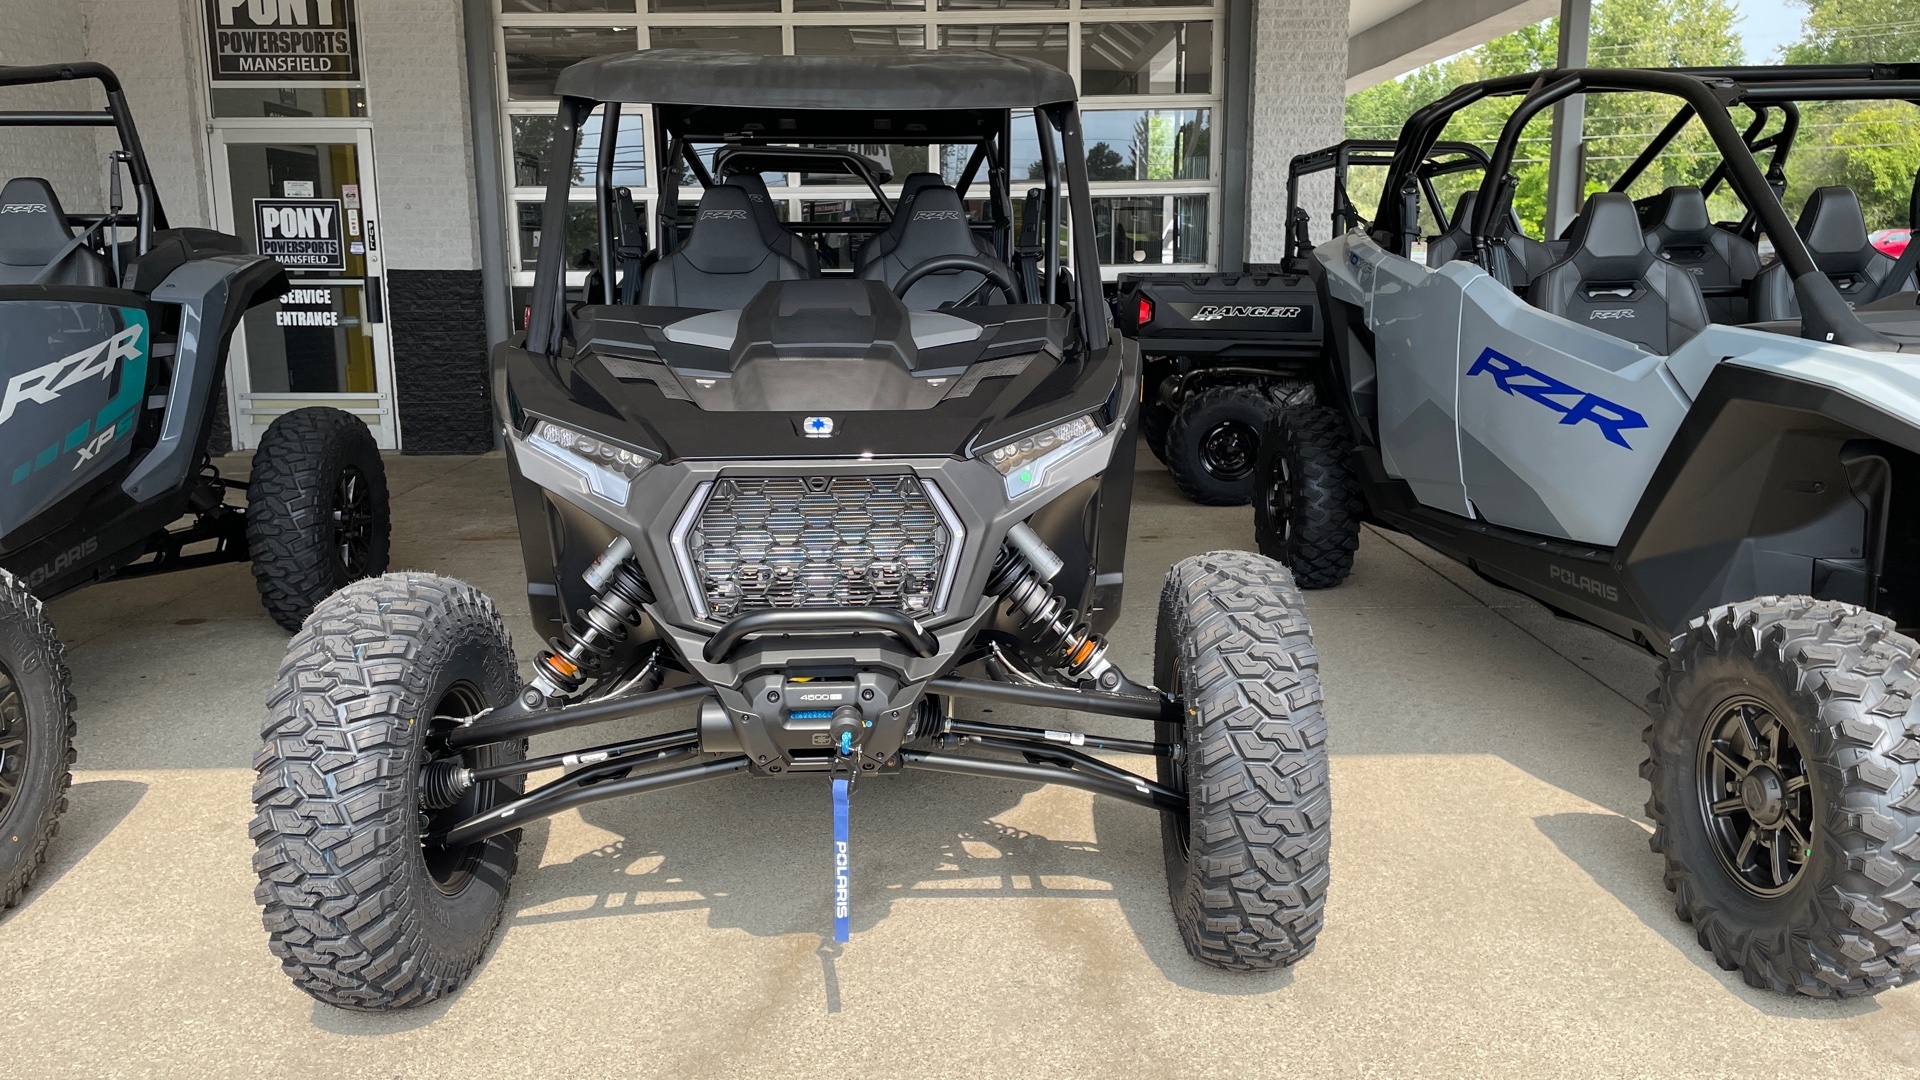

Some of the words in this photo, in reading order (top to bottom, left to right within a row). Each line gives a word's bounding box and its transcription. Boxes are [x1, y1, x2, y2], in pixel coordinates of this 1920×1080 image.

[219, 31, 348, 53] POWERSPORTS
[239, 57, 332, 72] MANSFIELD
[1, 203, 47, 214] RZR
[700, 209, 747, 220] RZR
[913, 210, 959, 221] RZR
[262, 207, 333, 238] PONY
[367, 222, 375, 249] PULL
[264, 240, 338, 254] POWERSPORTS
[275, 255, 329, 264] MANSFIELD
[280, 289, 332, 304] SERVICE
[275, 311, 339, 326] ENTRANCE
[1197, 305, 1301, 318] RANGER
[1590, 309, 1635, 320] RZR
[0, 323, 144, 425] RZR
[1466, 346, 1649, 451] RZR
[1549, 564, 1618, 602] POLARIS
[800, 693, 829, 701] 4500
[836, 841, 848, 919] POLARIS
